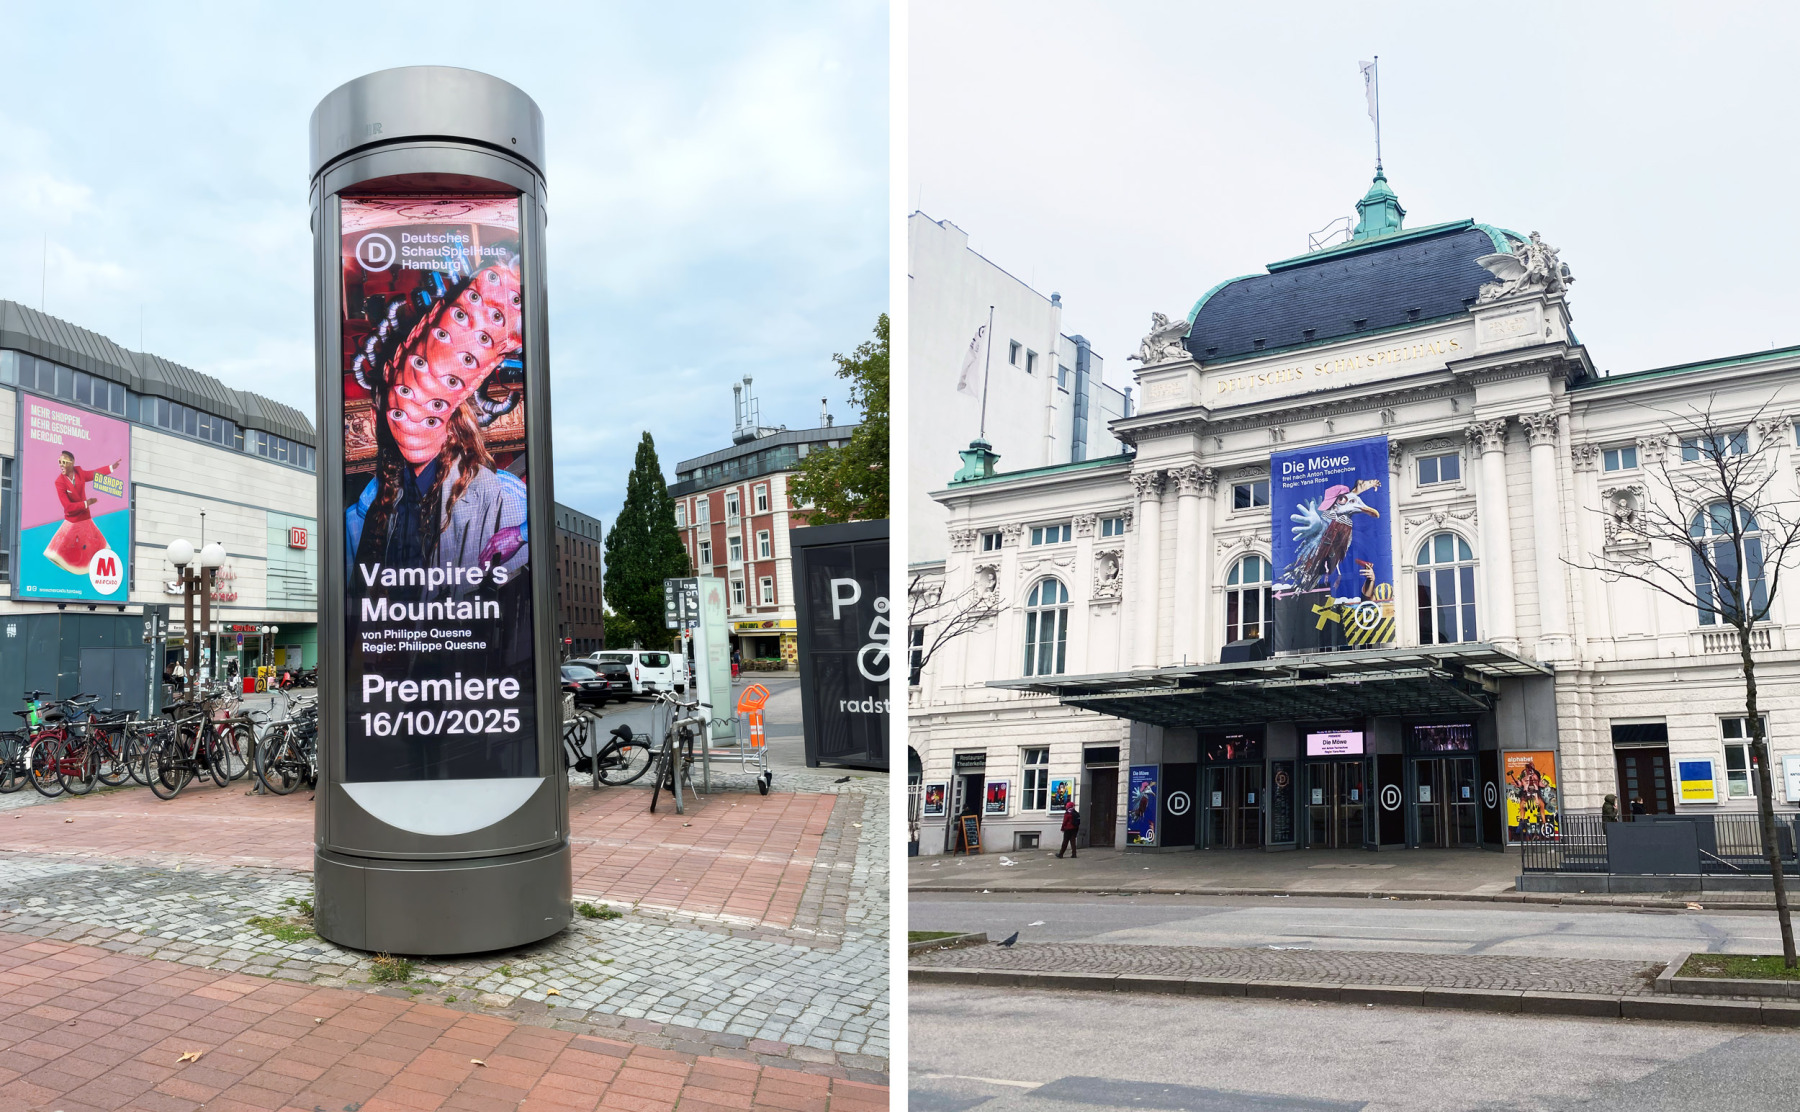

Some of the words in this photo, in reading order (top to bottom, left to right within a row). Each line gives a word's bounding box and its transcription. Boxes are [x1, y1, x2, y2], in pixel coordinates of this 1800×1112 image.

[401, 232, 470, 244] Deutsches
[401, 246, 507, 258] SchauSpielHaus
[401, 259, 461, 271] Hamburg
[1218, 367, 1303, 394] DEUTSCHES
[31, 404, 51, 419] MEHR
[51, 410, 83, 428] SHOPPEN.
[31, 416, 51, 431] MEHR
[30, 428, 64, 445] MERCADO.
[1282, 461, 1305, 474] Die
[1308, 455, 1349, 471] Möwe
[1324, 467, 1356, 475] Tschechow
[103, 475, 124, 490] SHOPS
[294, 530, 306, 545] DB
[96, 557, 116, 577] M
[359, 561, 509, 591] Vampire’s
[830, 577, 862, 620] P
[361, 595, 500, 622] Mountain
[362, 632, 382, 640] von
[383, 629, 428, 641] Philippe
[429, 628, 472, 639] Quesne
[362, 642, 396, 653] Regie:
[398, 640, 442, 652] Philippe
[444, 639, 487, 650] Quesne
[362, 672, 520, 703] Premiere
[360, 708, 521, 737] 16/10/2025
